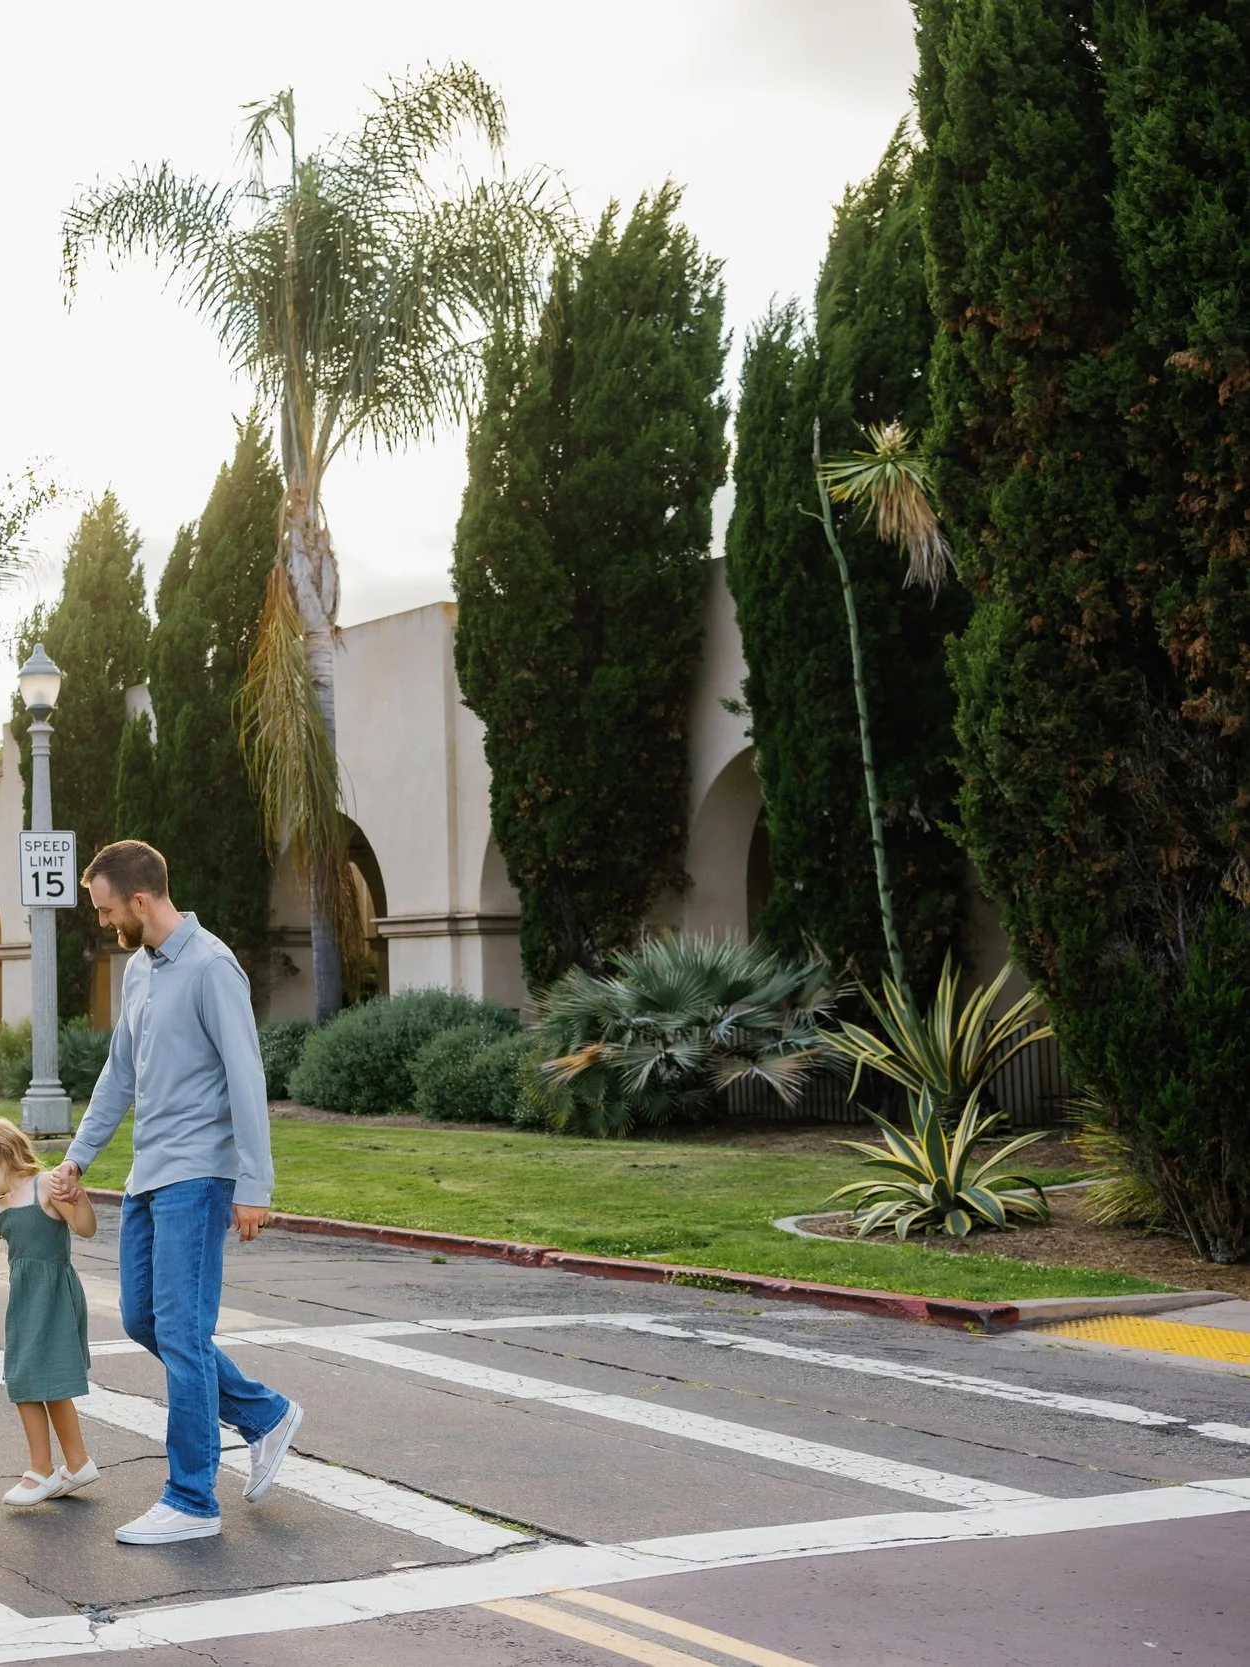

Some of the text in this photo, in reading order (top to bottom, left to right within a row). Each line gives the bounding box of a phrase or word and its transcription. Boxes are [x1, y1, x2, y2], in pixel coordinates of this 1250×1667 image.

[24, 841, 70, 852] SPEED
[30, 856, 65, 867] LIMIT
[32, 871, 65, 898] 15
